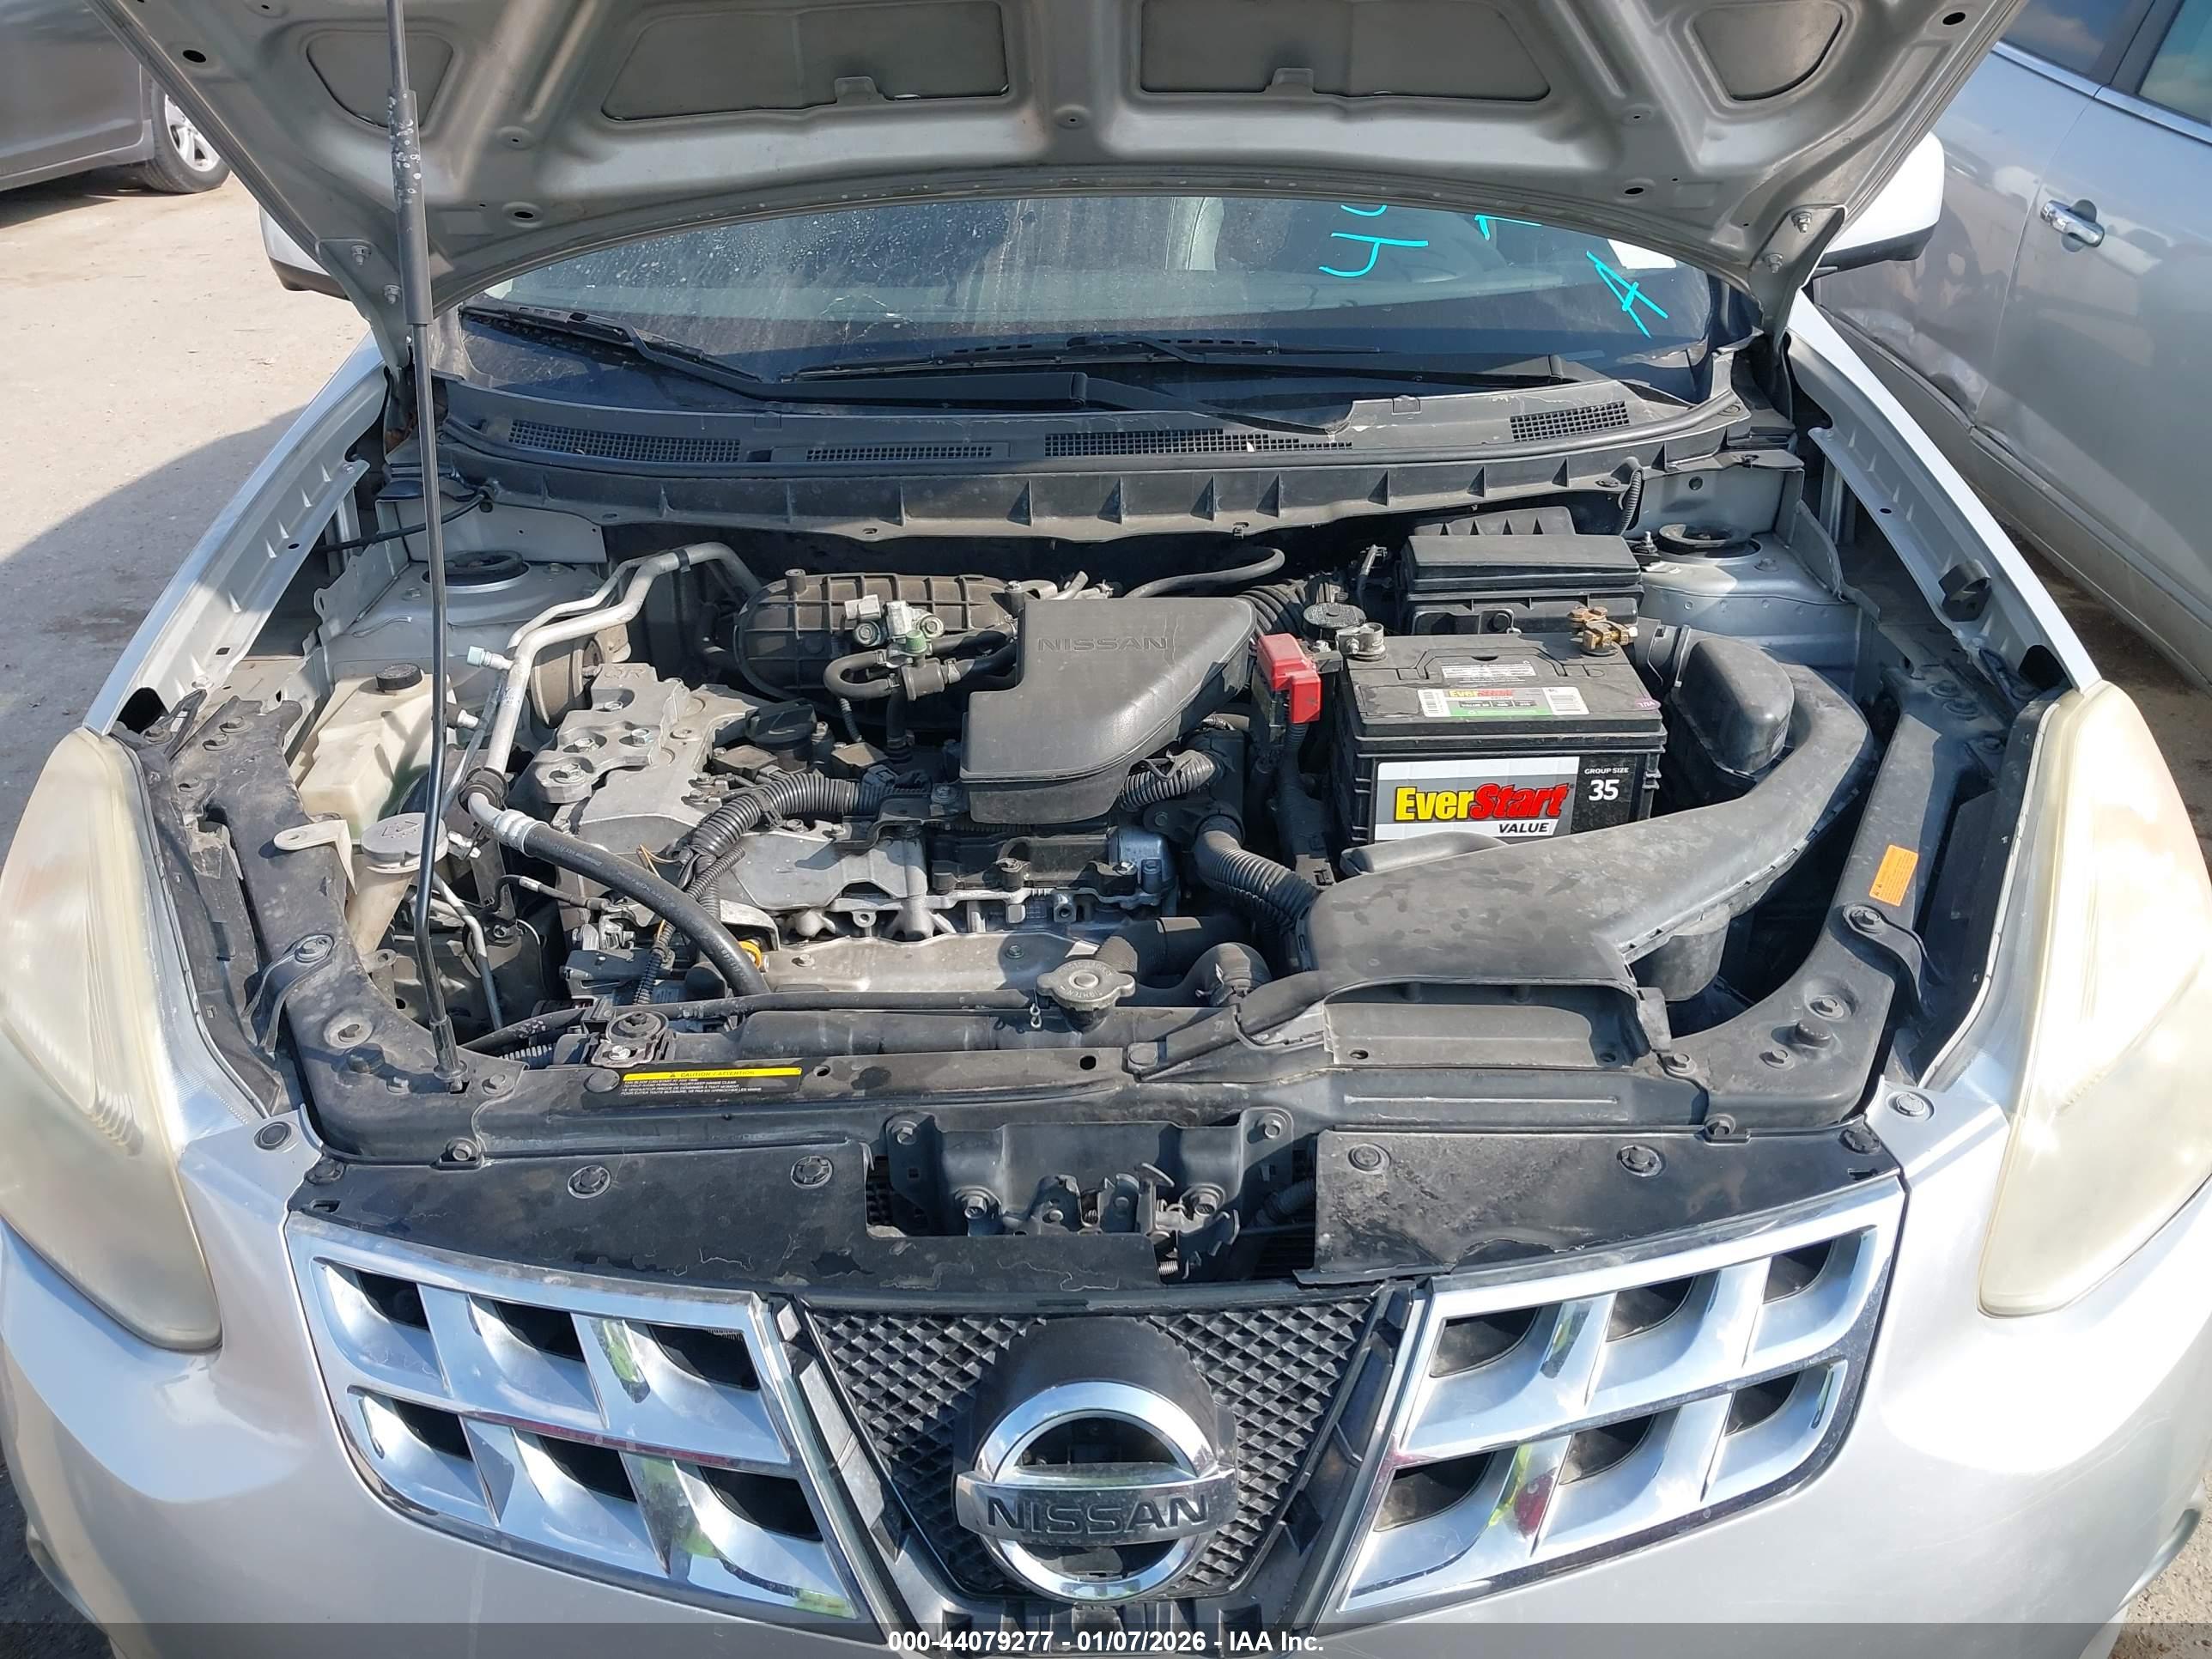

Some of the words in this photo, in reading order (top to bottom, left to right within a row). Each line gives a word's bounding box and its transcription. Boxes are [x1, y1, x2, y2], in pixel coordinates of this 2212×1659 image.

[1037, 637, 1168, 652] NISSAN
[1589, 779, 1620, 801] 35
[1395, 782, 1571, 822] EverStart
[1498, 822, 1550, 835] VALUE
[988, 1494, 1209, 1534] NISSAN
